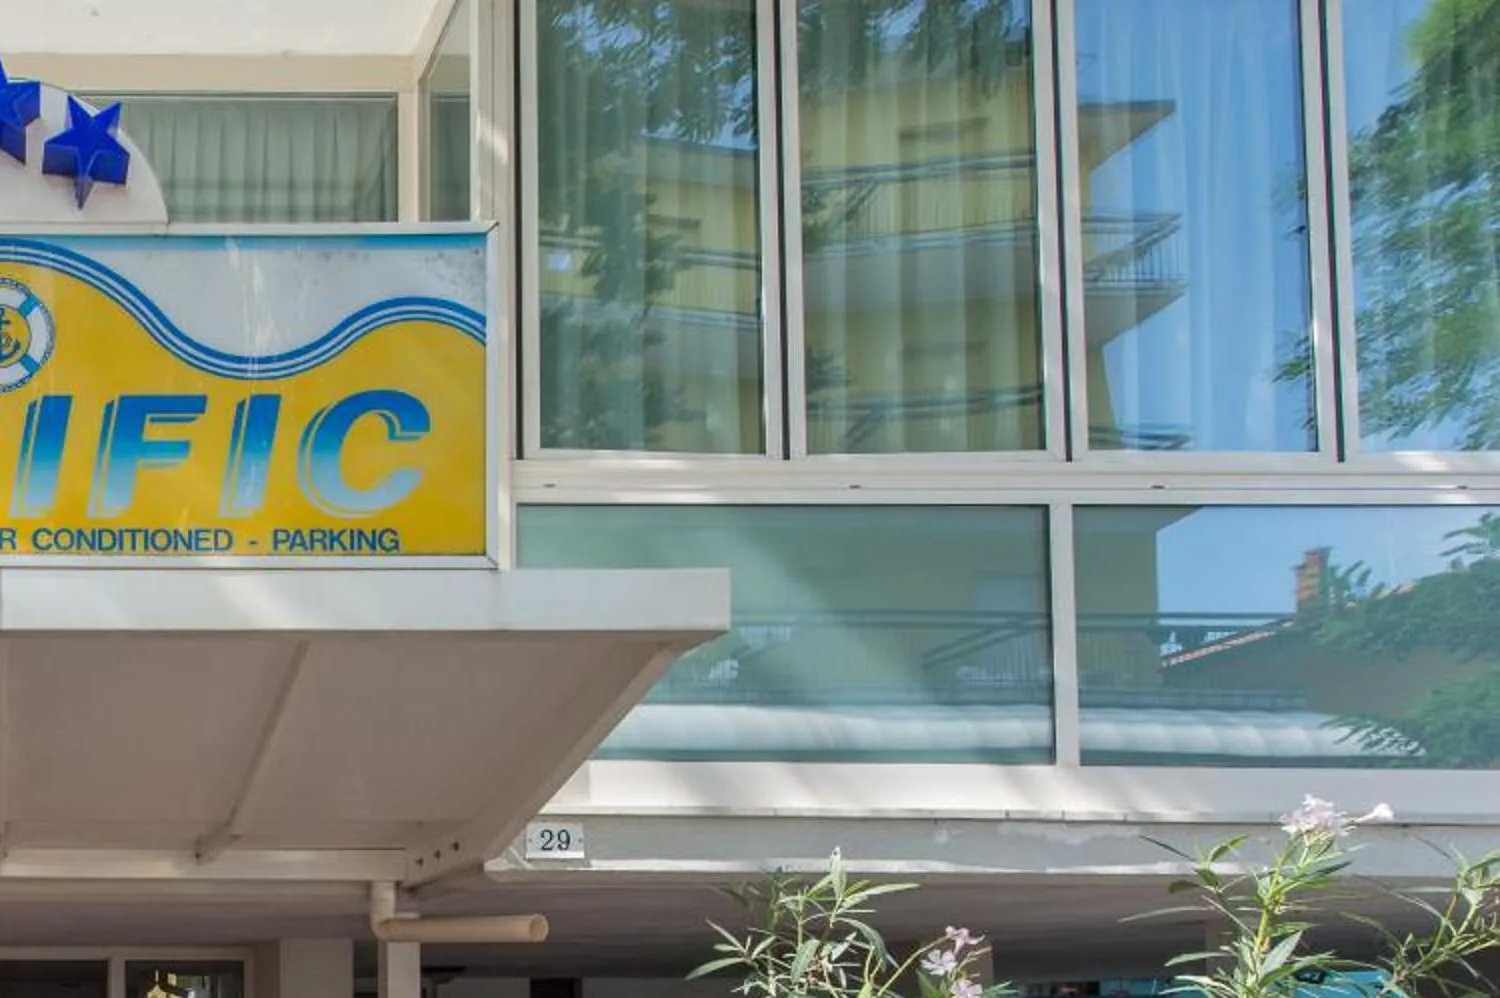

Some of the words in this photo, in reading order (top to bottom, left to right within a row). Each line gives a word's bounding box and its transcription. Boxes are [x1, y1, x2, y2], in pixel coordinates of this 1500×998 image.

[31, 528, 233, 552] CONDITIONED
[272, 529, 400, 553] PARKING
[540, 829, 571, 851] 29
